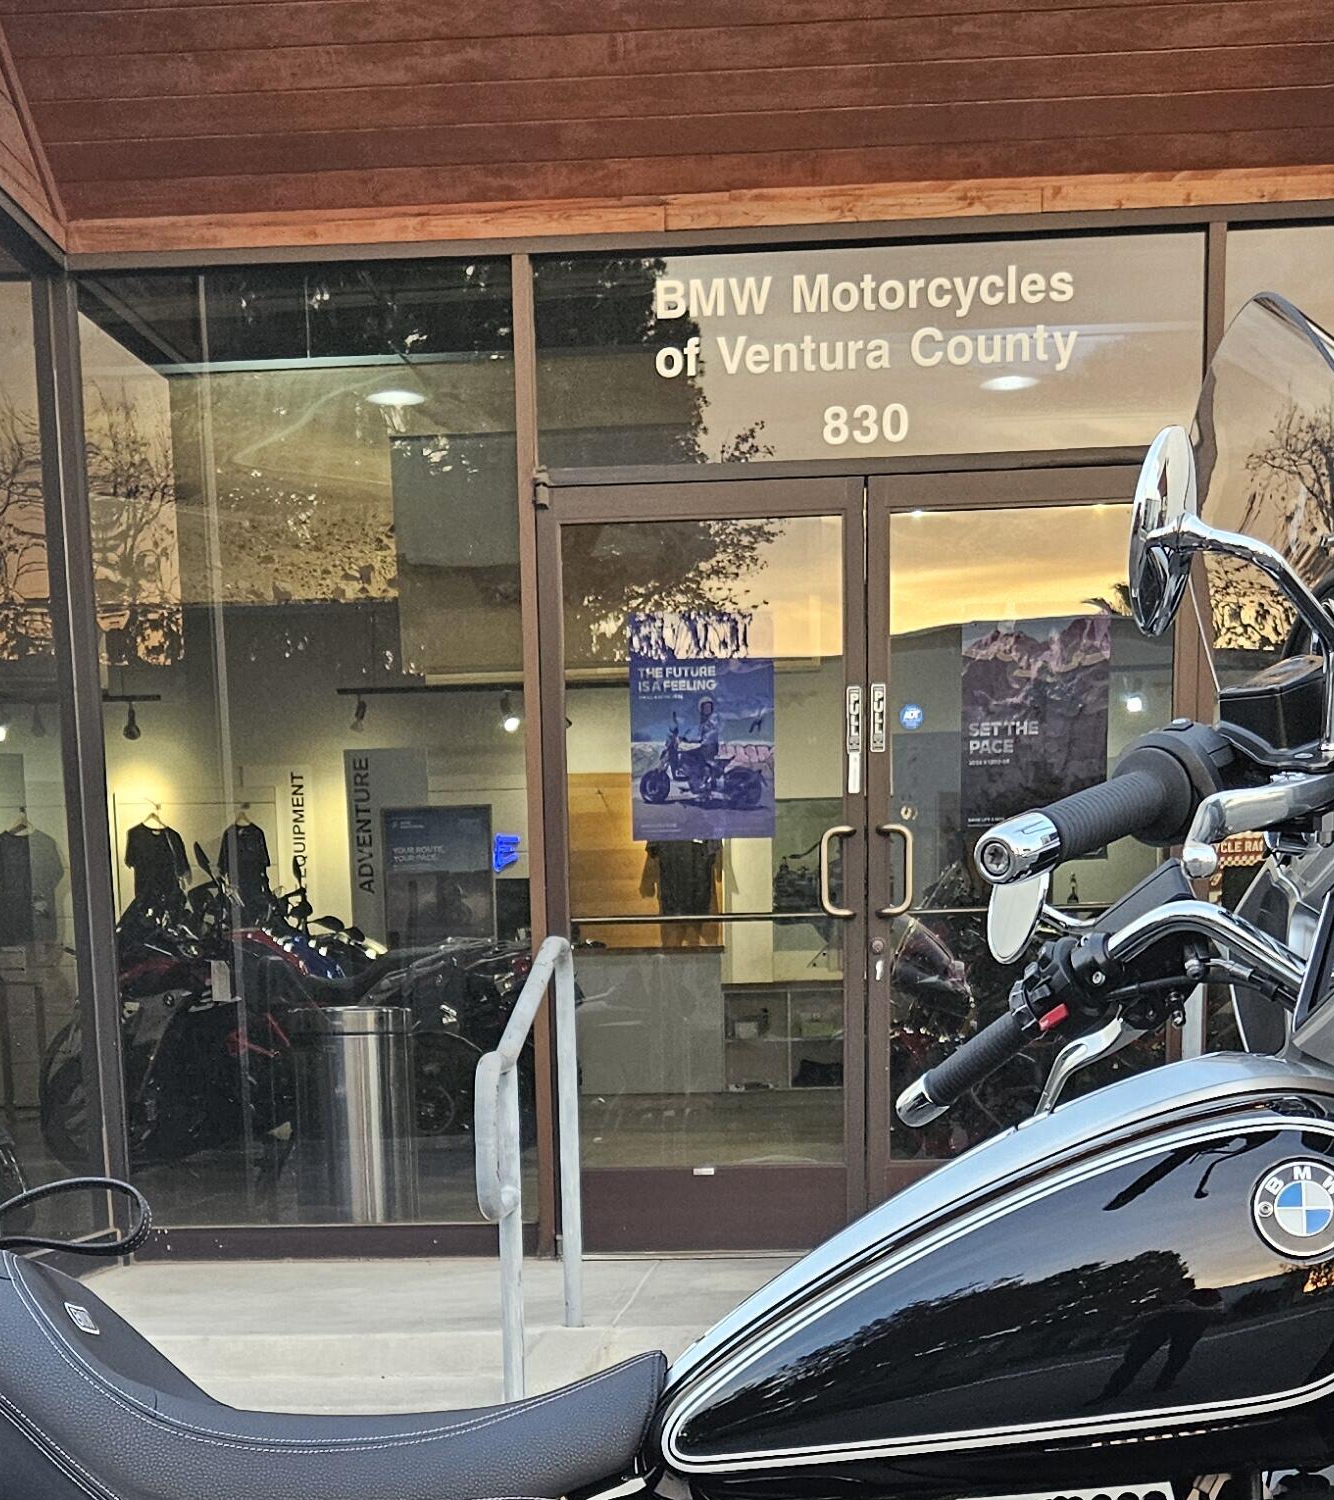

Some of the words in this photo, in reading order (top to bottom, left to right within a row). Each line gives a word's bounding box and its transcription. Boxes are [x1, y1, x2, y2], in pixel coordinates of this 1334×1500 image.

[655, 275, 773, 320] BMW
[793, 265, 1075, 318] Motorcycles
[655, 338, 702, 378] of
[717, 334, 891, 375] Ventura
[910, 324, 1079, 371] County
[822, 403, 909, 445] 830
[638, 667, 663, 679] THE
[665, 665, 716, 678] FUTURE
[638, 681, 651, 692] IS
[652, 681, 662, 692] A
[663, 679, 717, 692] FEELING
[849, 692, 860, 737] PULL
[873, 690, 884, 734] PULL
[969, 721, 1002, 737] SET
[1003, 720, 1039, 736] THE
[969, 739, 1015, 755] PACE
[353, 756, 375, 895] ADVENTURE
